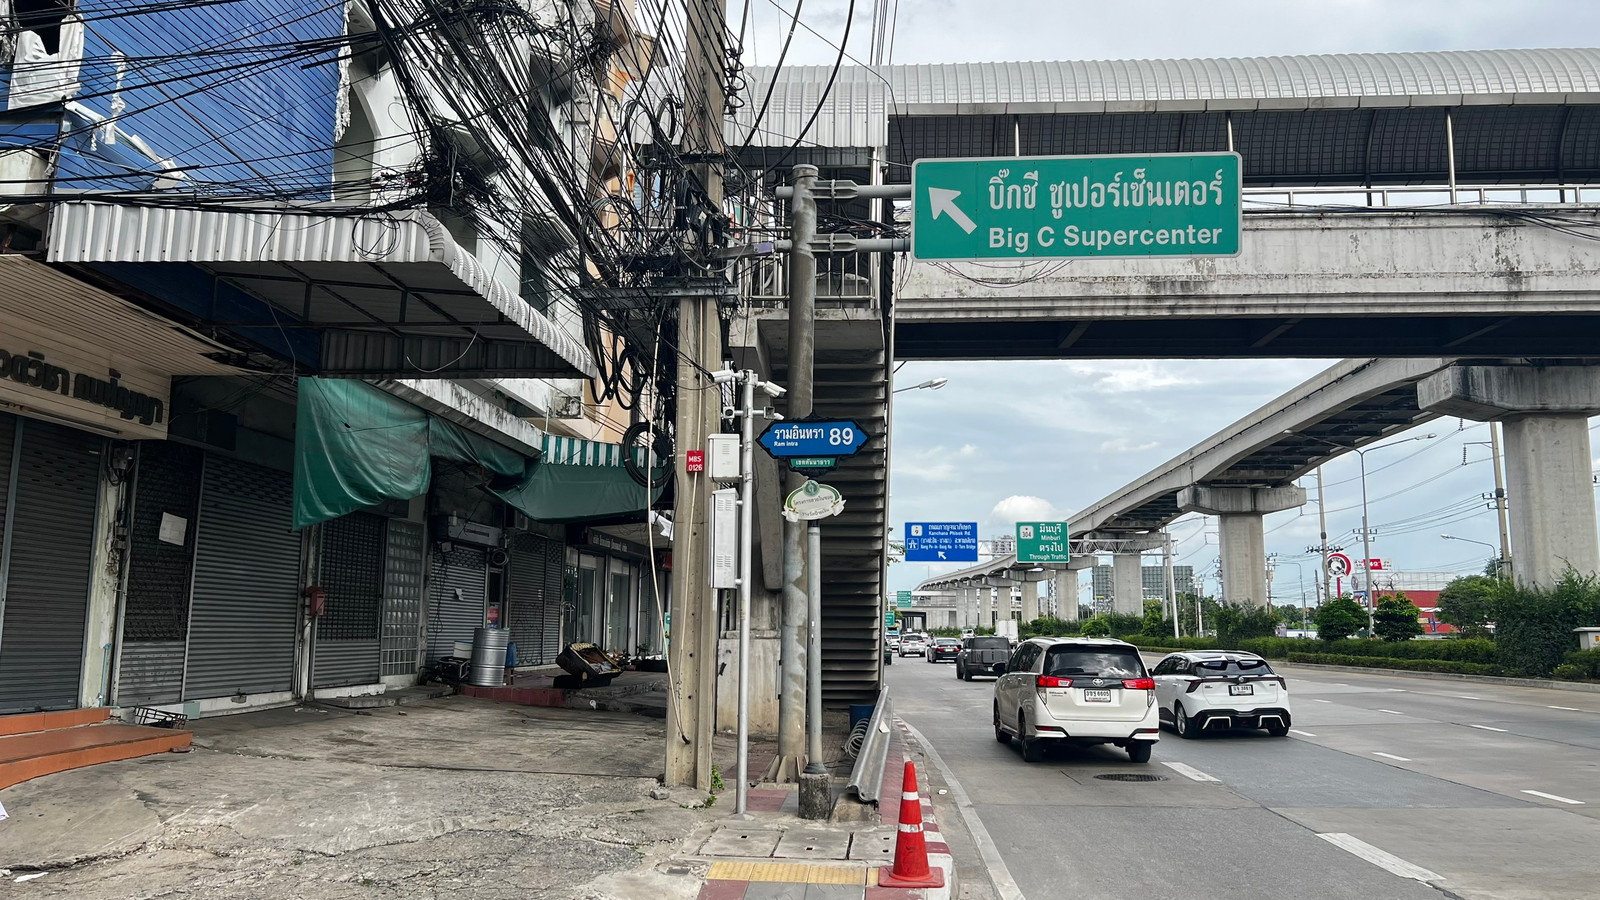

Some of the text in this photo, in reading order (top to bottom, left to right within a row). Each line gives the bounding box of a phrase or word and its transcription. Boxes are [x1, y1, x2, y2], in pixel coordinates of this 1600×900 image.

[988, 167, 1223, 220] บิ๊กซี ซูเปอร์เซ็นเตอร์
[989, 224, 1223, 253] Big C Supercenter
[774, 425, 854, 446] รามอินทรา 89
[688, 455, 702, 463] MBS
[688, 464, 703, 472] 0126
[1039, 523, 1062, 535] มีนบุรี
[1039, 542, 1063, 552] ตรงไป
